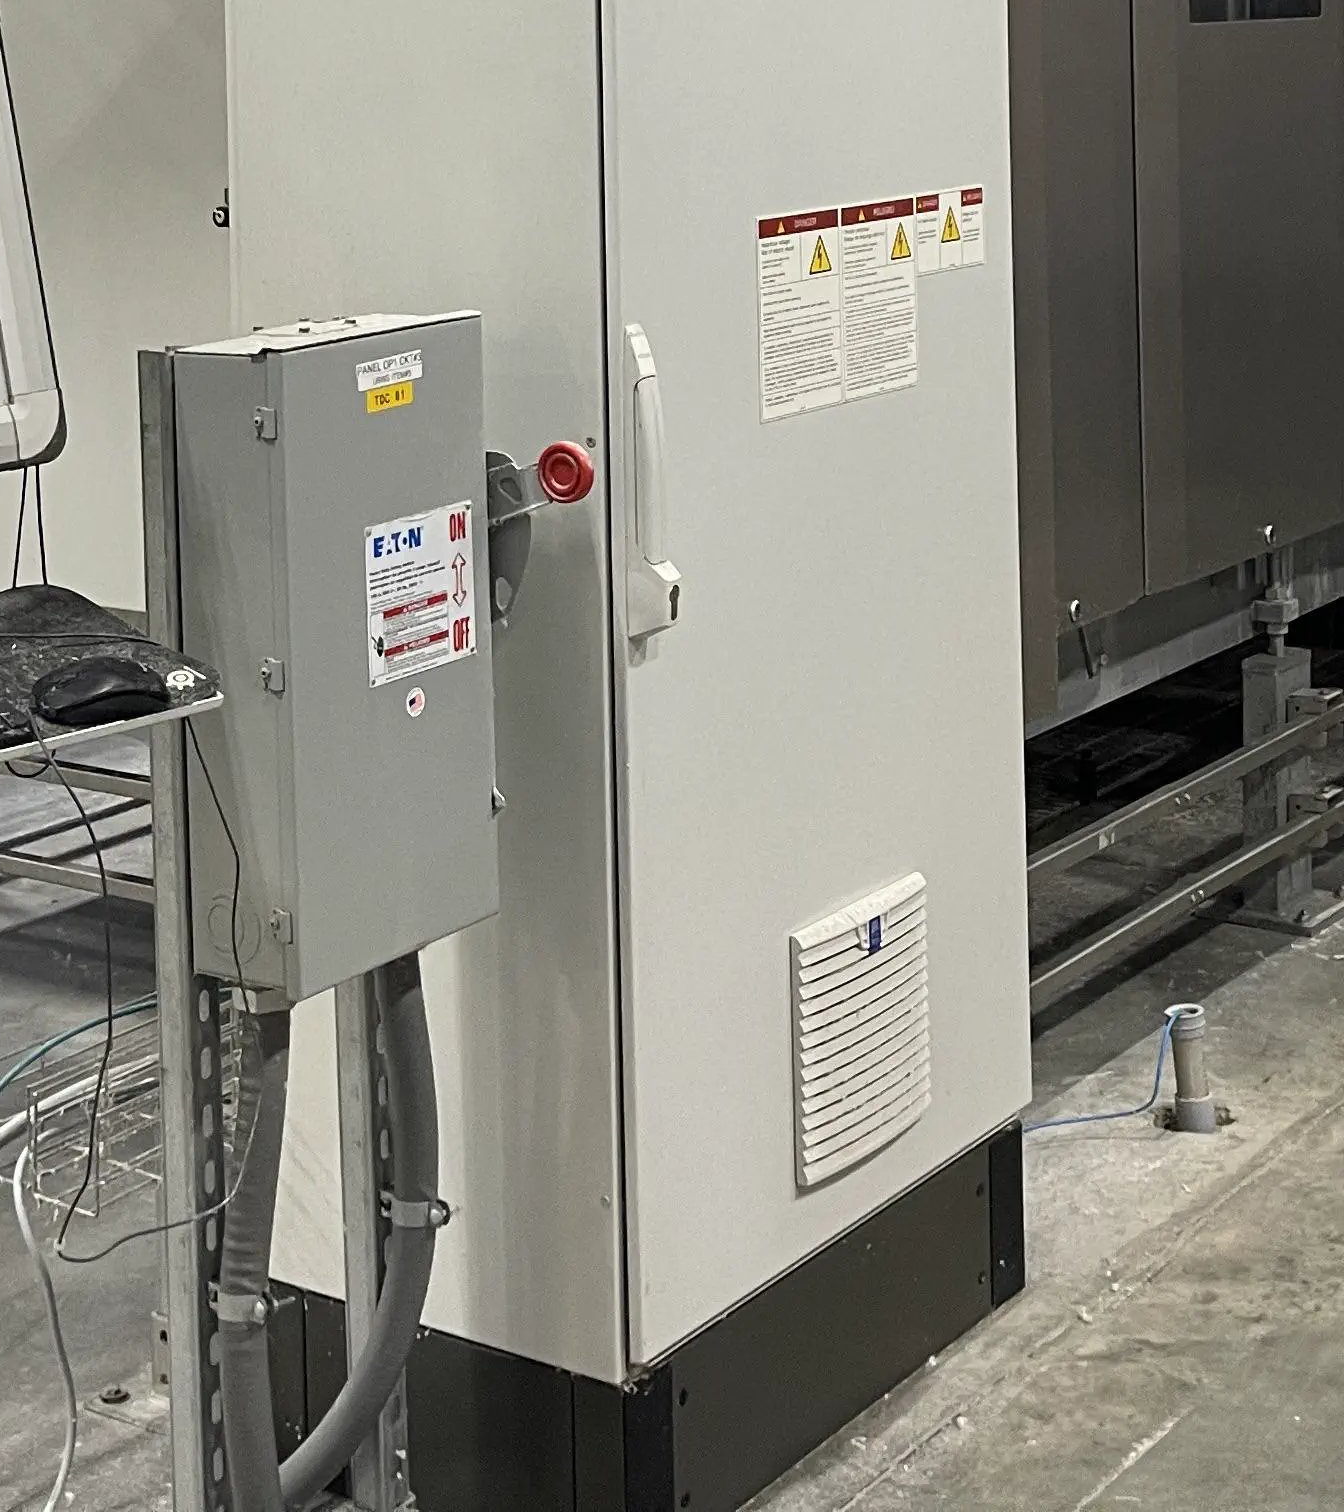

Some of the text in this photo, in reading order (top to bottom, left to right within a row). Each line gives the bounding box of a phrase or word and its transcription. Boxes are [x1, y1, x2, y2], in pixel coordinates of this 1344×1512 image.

[357, 362, 381, 377] PANEL
[449, 510, 466, 542] ON
[373, 526, 422, 559] EATON
[453, 615, 470, 652] OFF
